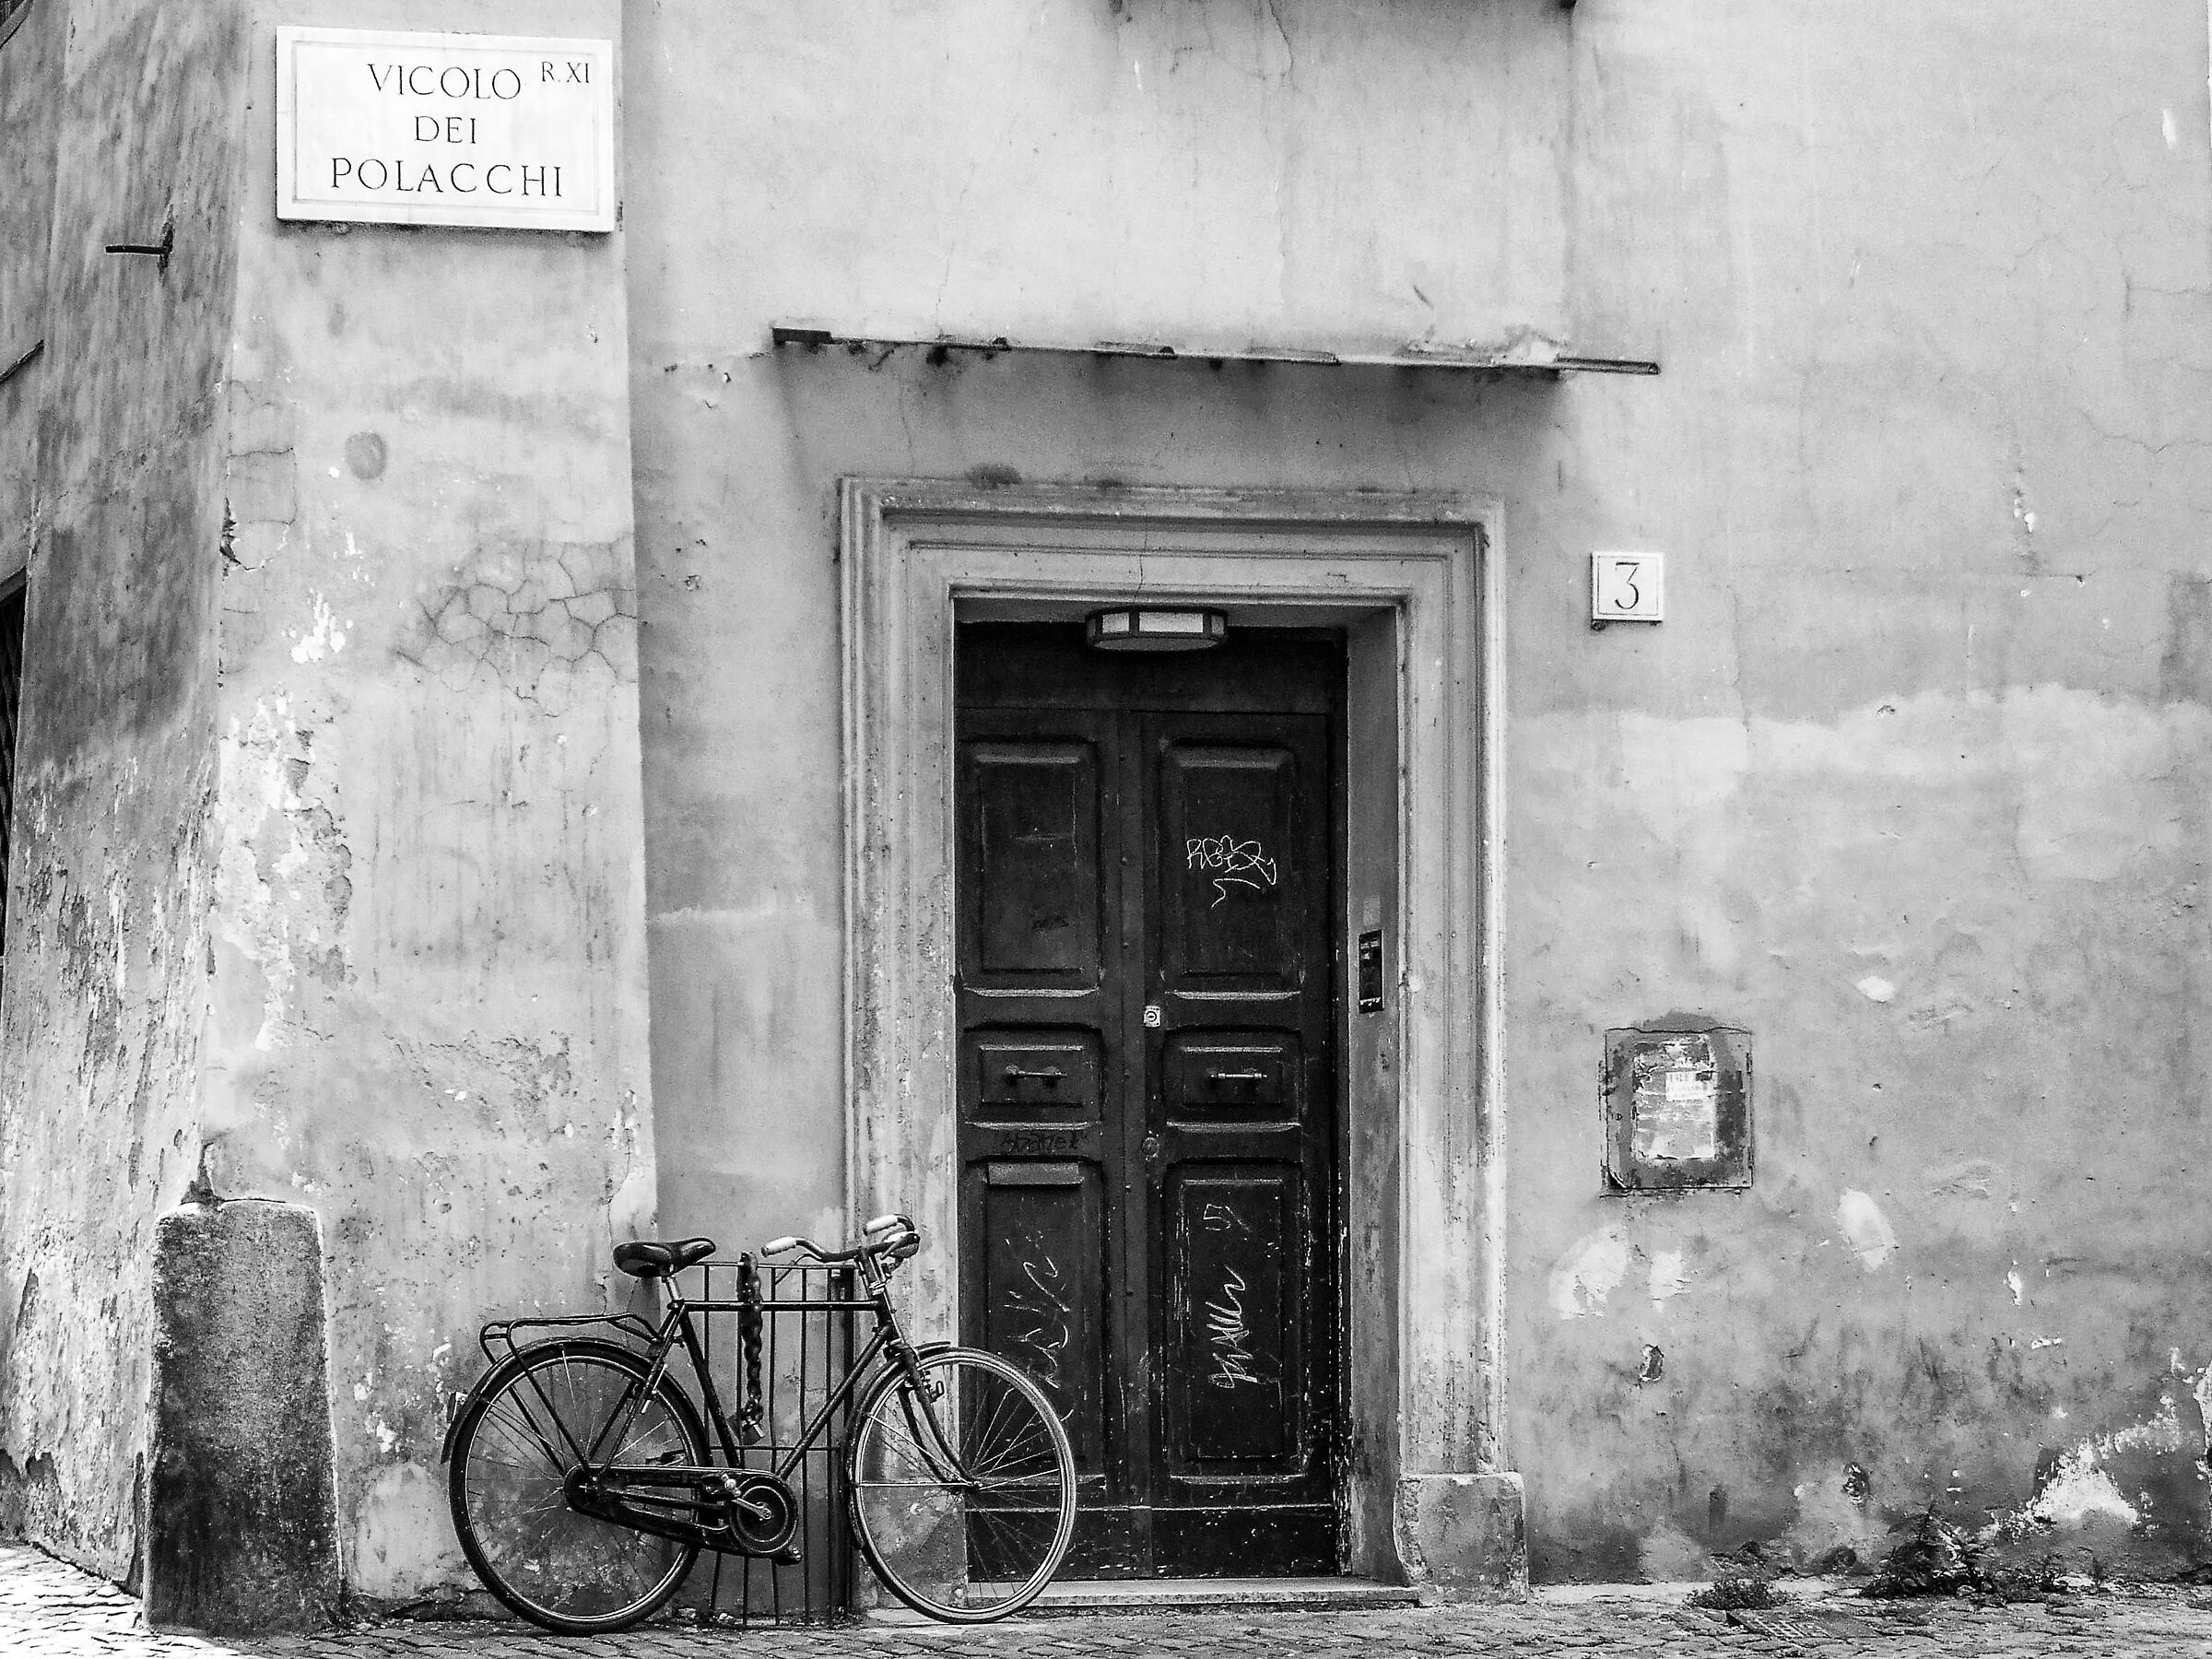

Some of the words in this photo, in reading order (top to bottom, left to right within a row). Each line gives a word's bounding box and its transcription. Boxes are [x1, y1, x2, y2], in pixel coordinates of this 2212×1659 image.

[367, 63, 522, 100] VICOLO
[414, 115, 477, 144] DEI
[330, 157, 562, 197] POLACCHI
[1614, 561, 1640, 610] 3
